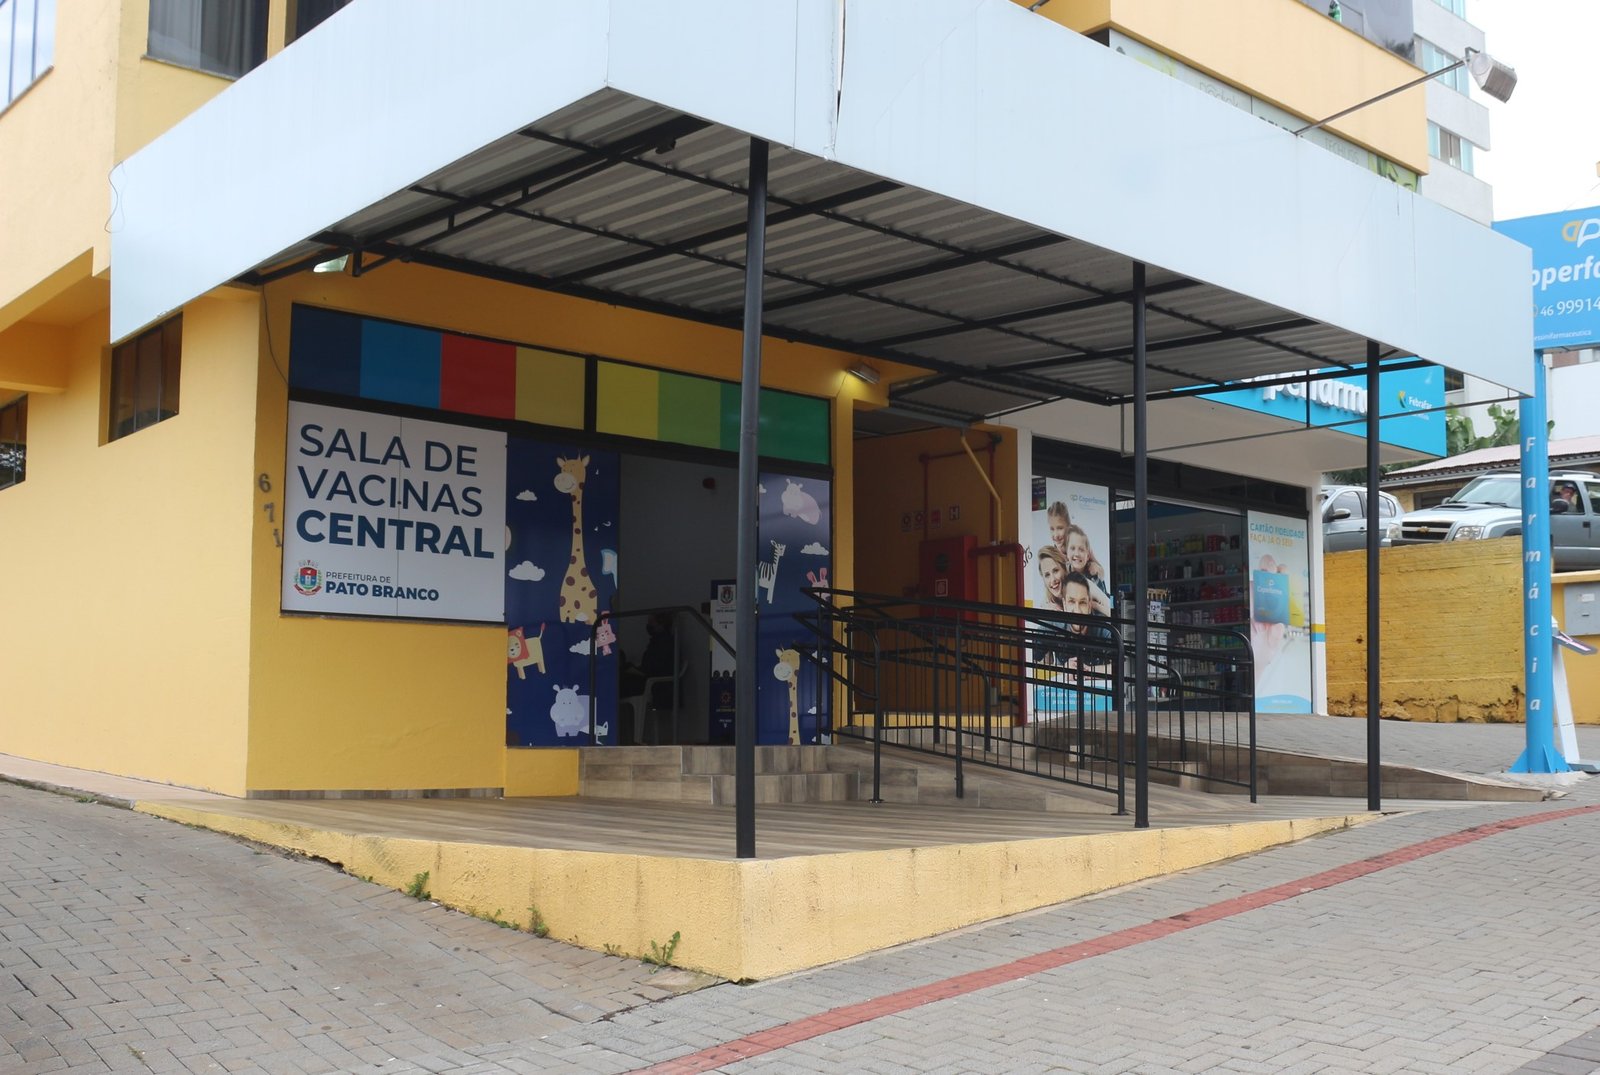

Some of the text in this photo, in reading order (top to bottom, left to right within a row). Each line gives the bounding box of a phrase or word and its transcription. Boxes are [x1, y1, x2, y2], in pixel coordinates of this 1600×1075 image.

[1540, 304, 1554, 317] 46
[299, 423, 478, 477] SALA DE
[297, 465, 483, 517] VACINAS
[296, 509, 495, 559] CENTRAL
[325, 571, 392, 584] PREFEITURA DE
[325, 580, 440, 602] PATO BRANCO
[1524, 436, 1542, 711] Farmácia
